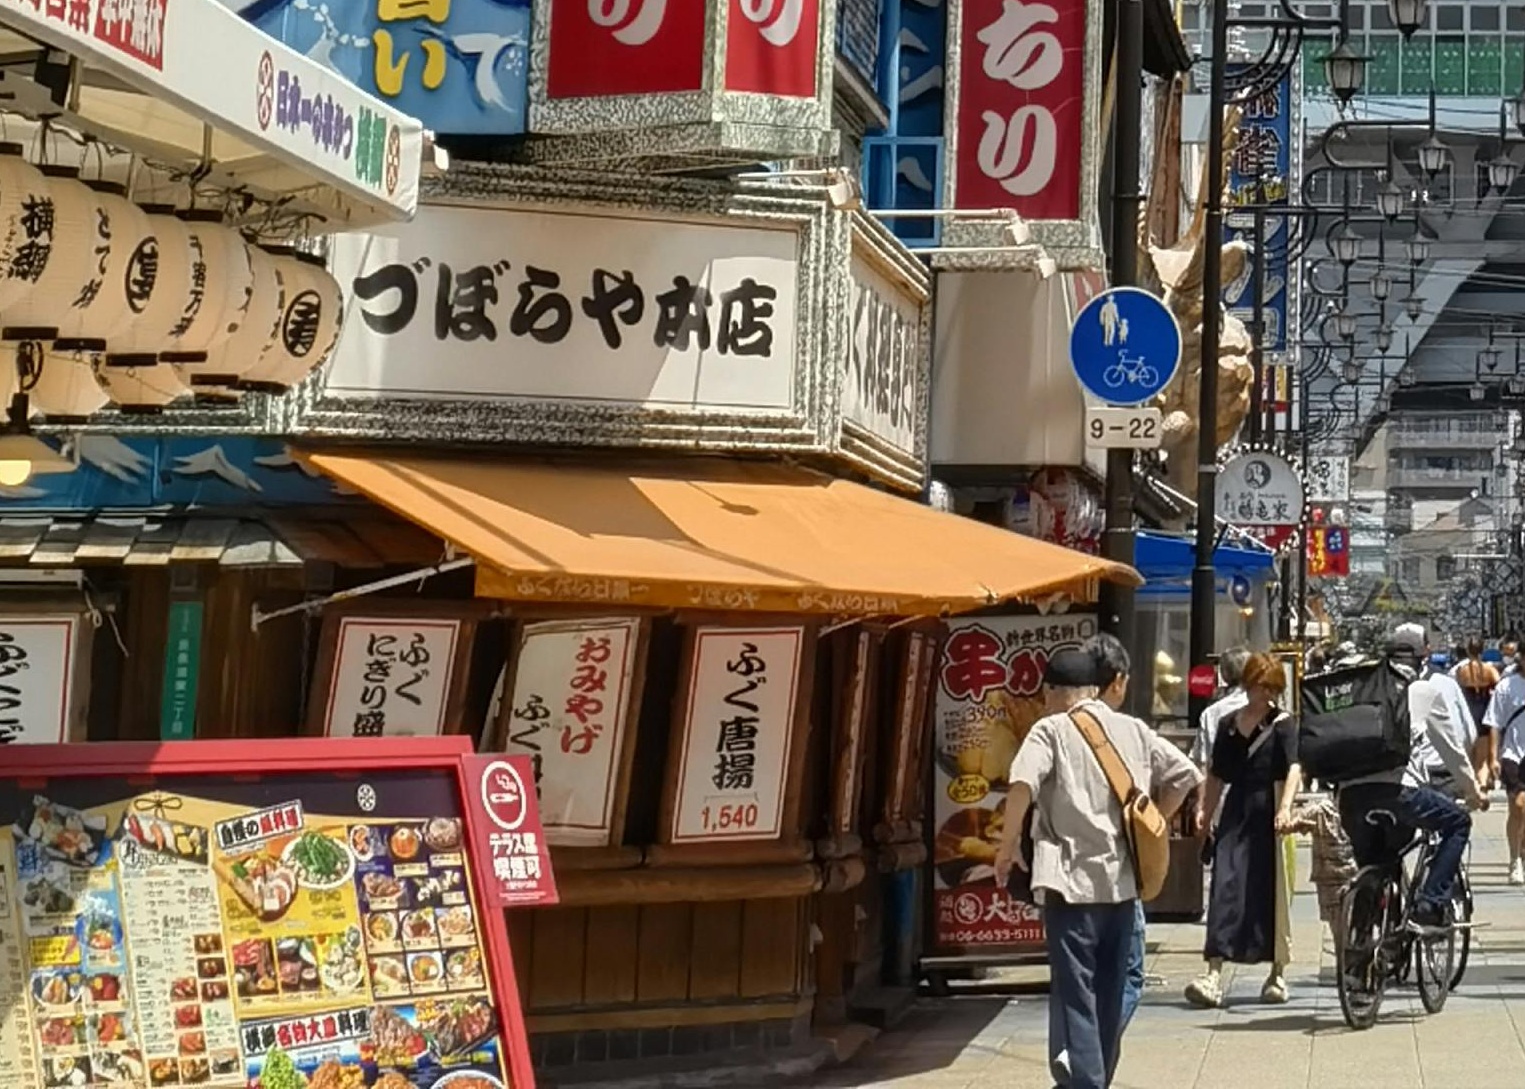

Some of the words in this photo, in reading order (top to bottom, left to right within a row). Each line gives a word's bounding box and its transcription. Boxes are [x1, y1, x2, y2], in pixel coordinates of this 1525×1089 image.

[353, 257, 777, 357] づぼらや本店
[395, 633, 430, 706] ふぐ
[561, 637, 611, 755] おみやげ
[944, 627, 1048, 701] 串か
[711, 642, 767, 790] ふぐ唐揚
[702, 804, 759, 831] 1,540
